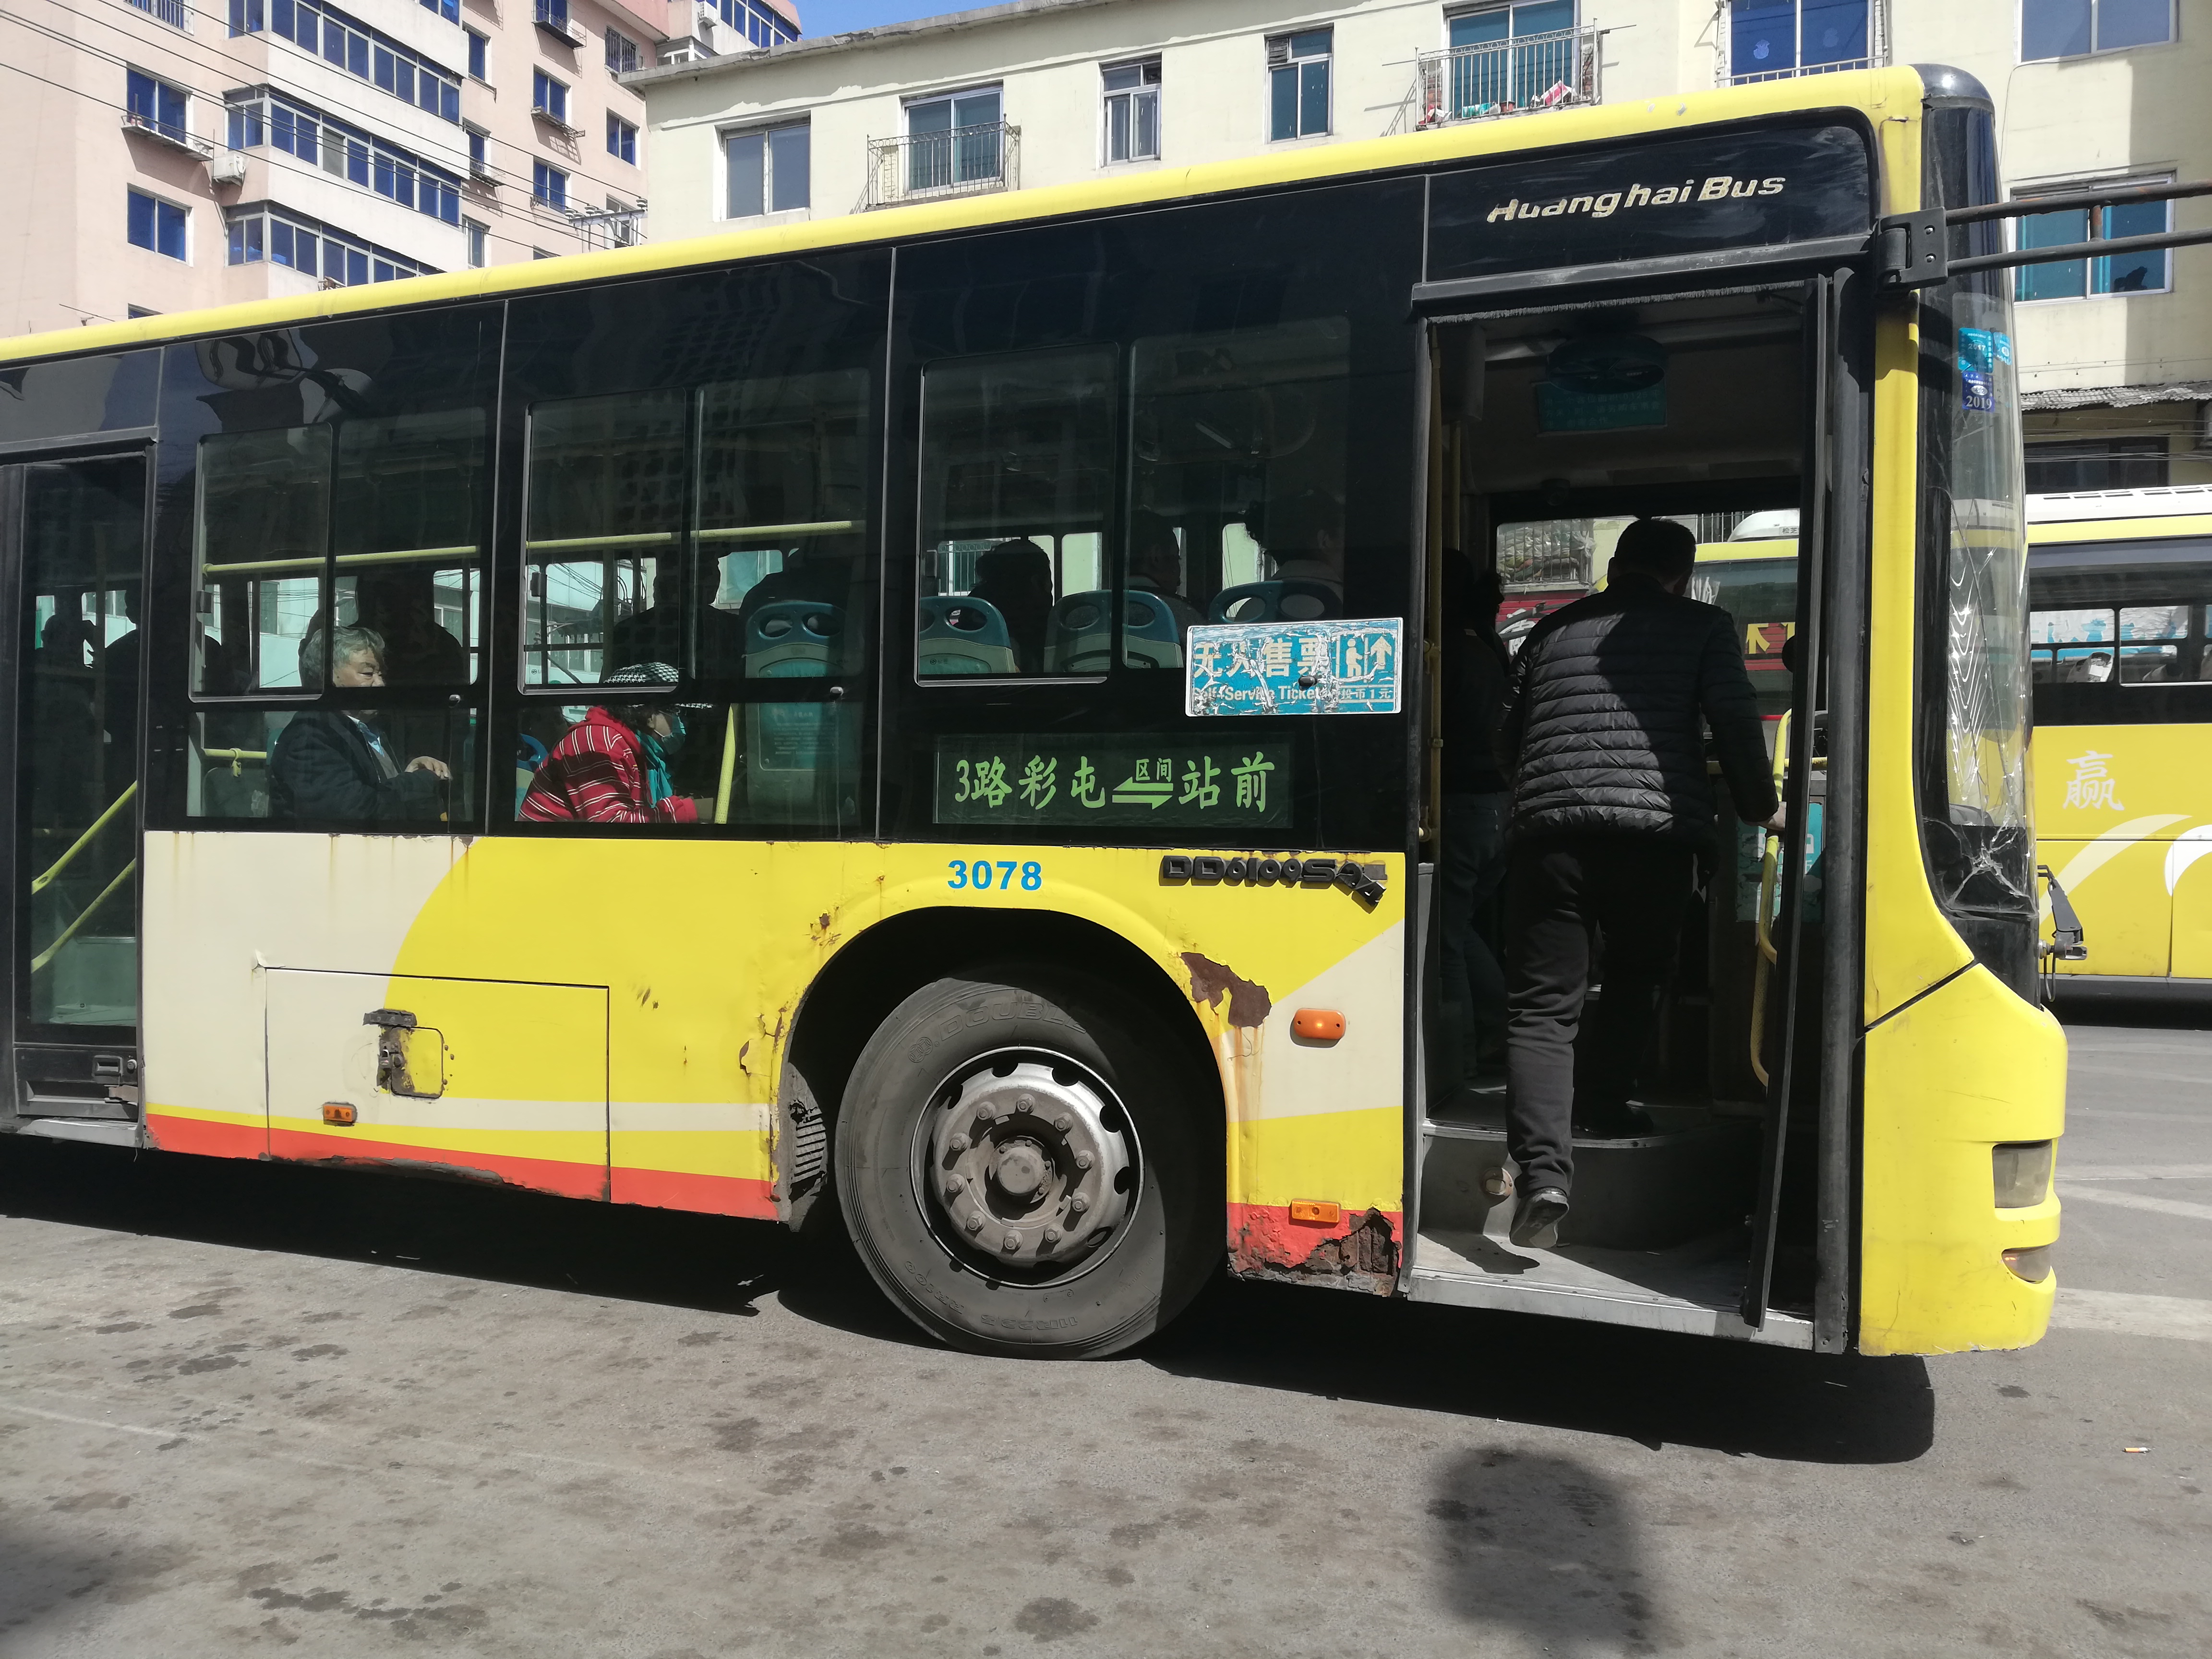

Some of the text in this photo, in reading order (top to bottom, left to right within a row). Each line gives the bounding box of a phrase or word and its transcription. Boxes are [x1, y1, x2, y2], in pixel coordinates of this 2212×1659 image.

[1487, 176, 1786, 222] Huanghai Bus
[1966, 396, 1992, 409] 2019
[954, 751, 1275, 813] 3路彩屯 区间 站前
[2063, 750, 2125, 811] 赢
[947, 860, 1042, 891] 3078
